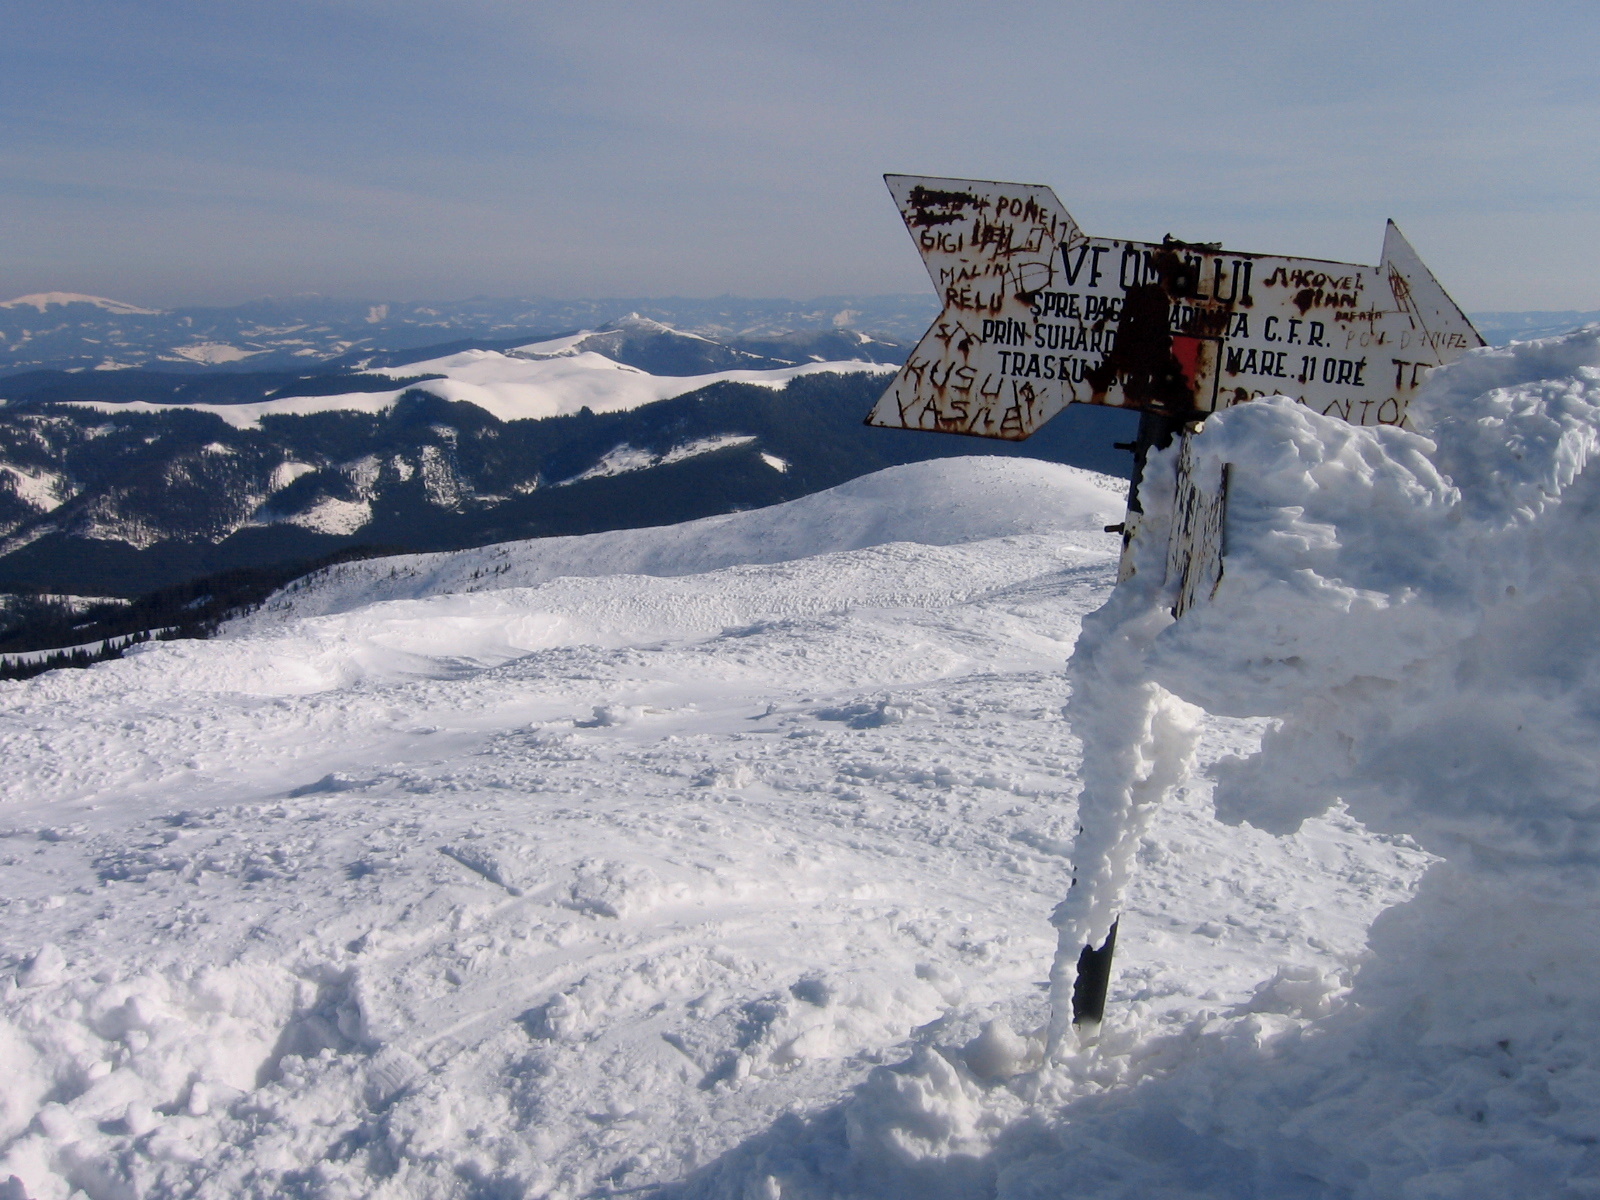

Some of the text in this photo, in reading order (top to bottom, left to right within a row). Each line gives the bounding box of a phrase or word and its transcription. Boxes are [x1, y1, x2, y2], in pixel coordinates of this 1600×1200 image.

[982, 318, 1026, 348] PRIN
[1030, 292, 1080, 320] SPRE
[1264, 316, 1331, 348] C.F.R.
